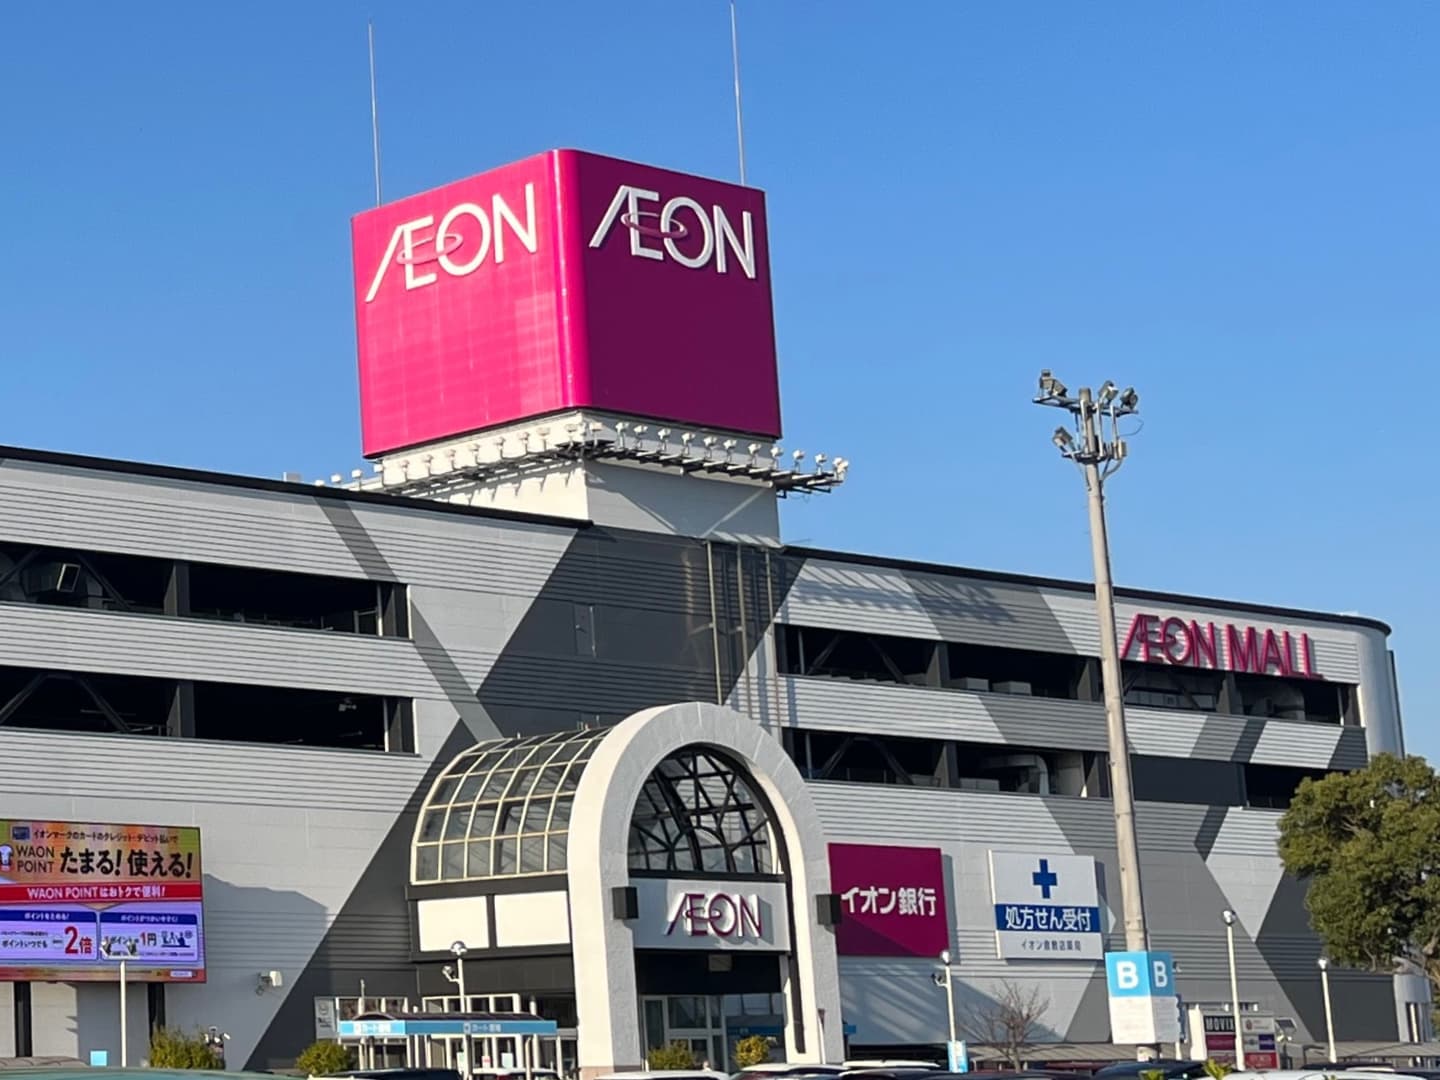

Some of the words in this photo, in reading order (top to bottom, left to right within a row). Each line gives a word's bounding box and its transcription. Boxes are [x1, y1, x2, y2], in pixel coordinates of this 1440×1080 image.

[1225, 624, 1323, 679] MALL
[16, 845, 55, 858] WAON
[17, 860, 54, 873] POINT
[27, 887, 62, 899] WAON
[65, 886, 98, 898] POINT
[841, 886, 937, 916] イオン銀行
[1005, 906, 1091, 931] 処方せん受付
[1116, 961, 1139, 989] B
[1153, 961, 1168, 987] B
